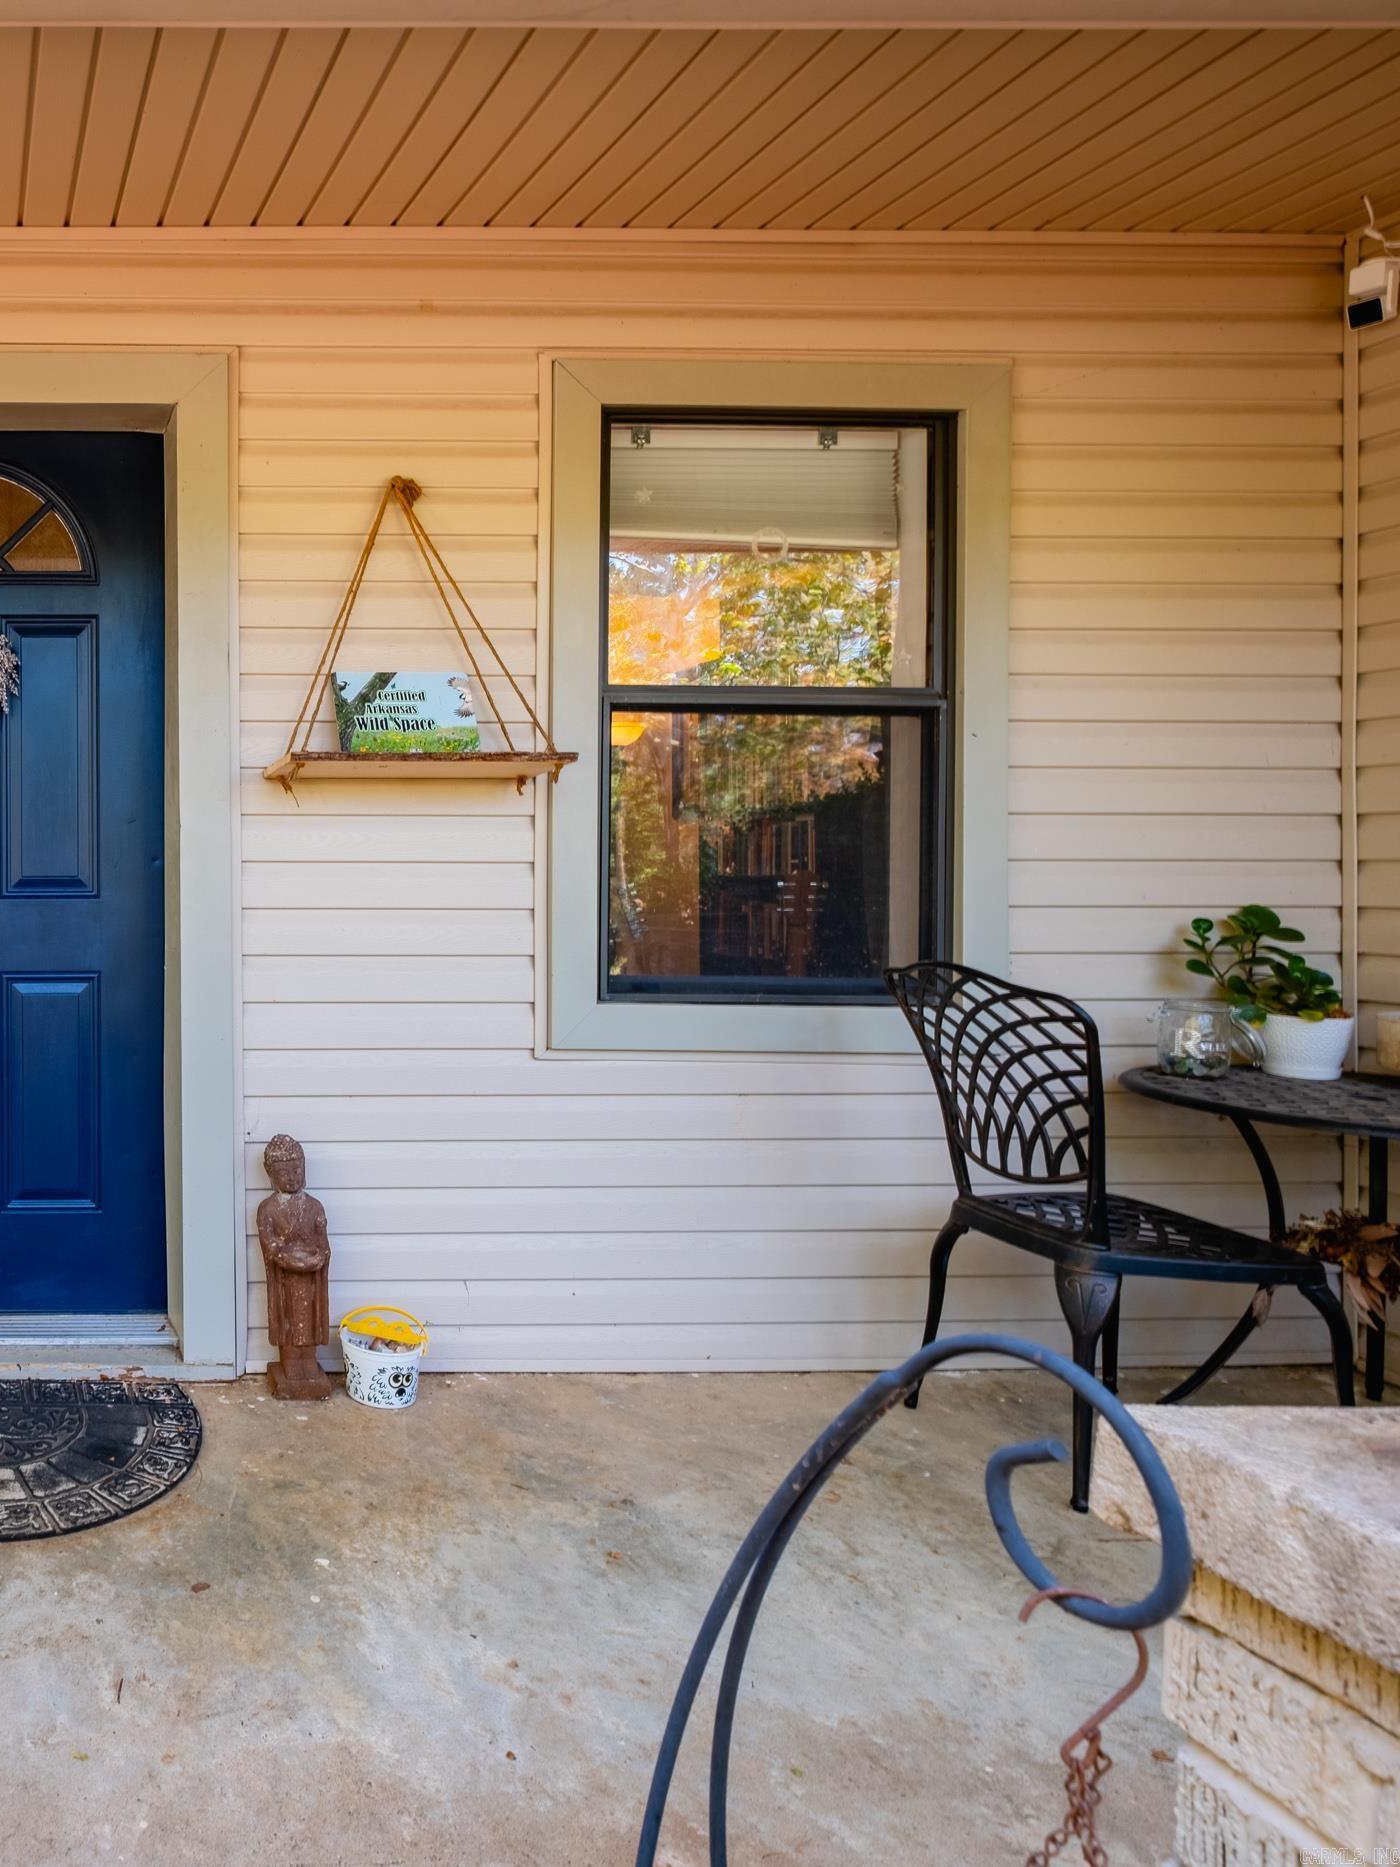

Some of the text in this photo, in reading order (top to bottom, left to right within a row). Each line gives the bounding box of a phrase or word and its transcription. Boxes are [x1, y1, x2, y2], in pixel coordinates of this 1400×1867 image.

[377, 691, 425, 701] Certified
[366, 704, 418, 714] Arkansas
[355, 717, 436, 733] Wild Space
